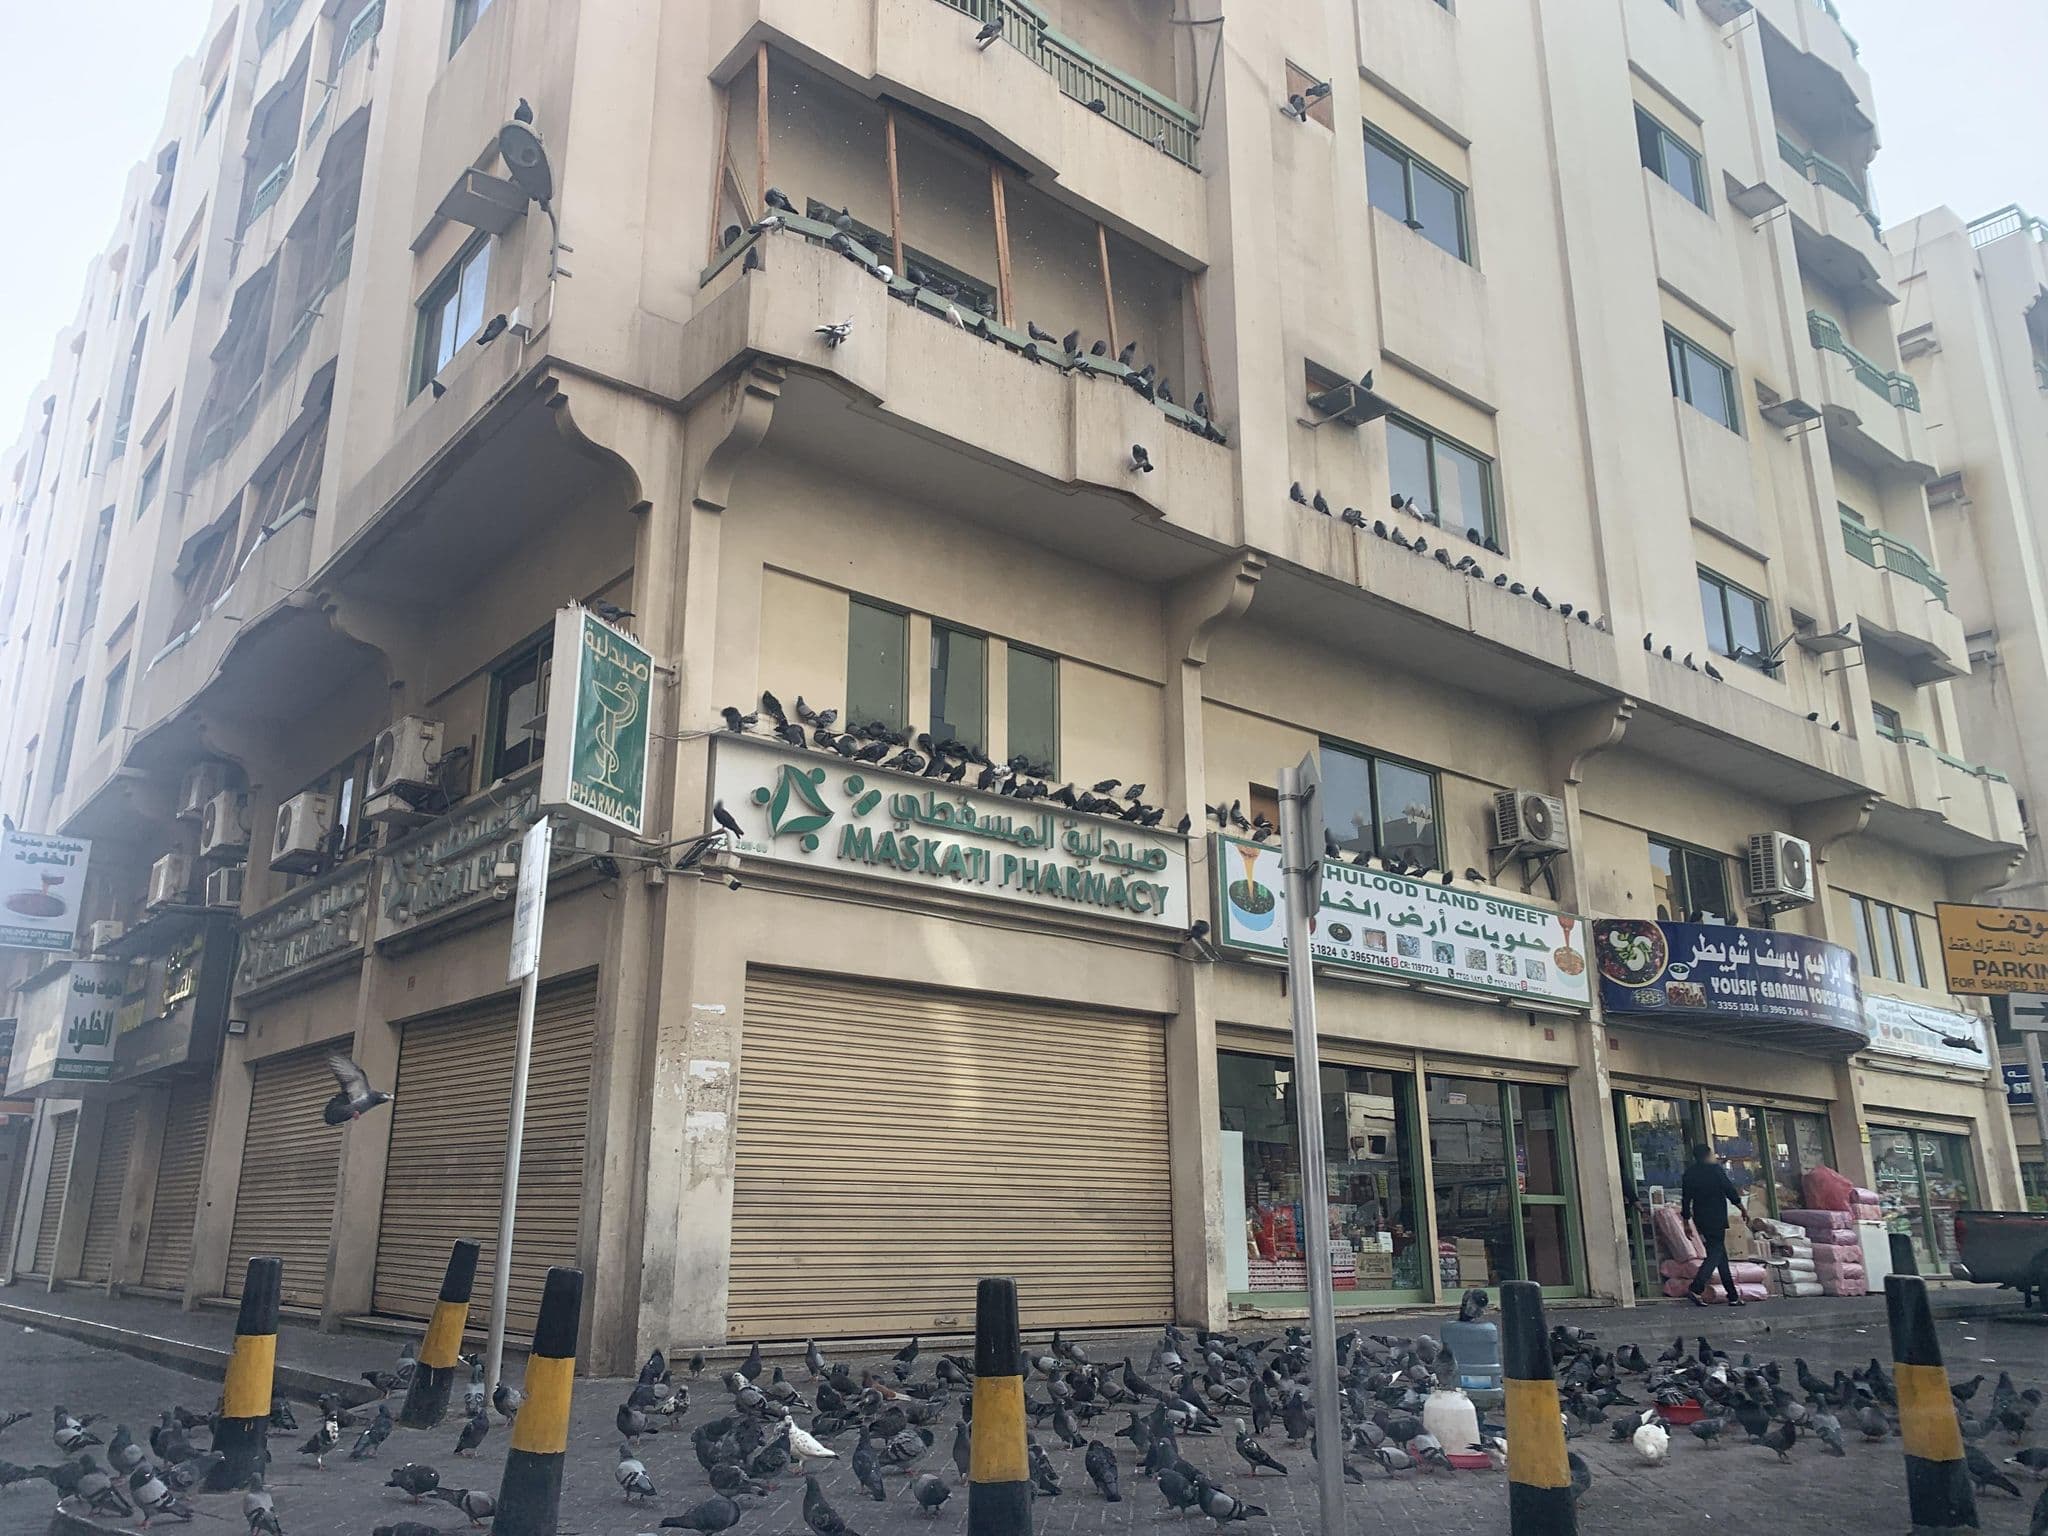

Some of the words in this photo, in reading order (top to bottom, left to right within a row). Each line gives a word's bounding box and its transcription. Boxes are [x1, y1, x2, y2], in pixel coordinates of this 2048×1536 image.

[583, 622, 649, 682] صيدلية
[571, 782, 640, 829] PHARMACY
[889, 791, 1054, 850] المسقطي
[15, 850, 75, 866] الخلود
[46, 839, 83, 852] حلويات
[1063, 819, 1168, 877] صيدلية
[838, 823, 990, 884] MASKATI
[997, 853, 1169, 916] PHARMACY
[1321, 864, 1418, 897] HULOOD
[1425, 888, 1479, 911] LAND
[1486, 901, 1549, 926] SWEET
[1387, 905, 1447, 937] أرض
[1454, 919, 1550, 953] حلويات
[1317, 944, 1338, 957] 1824
[1350, 949, 1390, 967] 39657146
[1686, 933, 1750, 971] شويطر
[1755, 938, 1802, 980] يوسف
[1711, 976, 1757, 995] YOUSIF
[1952, 977, 1976, 989] FOR
[1981, 979, 2028, 992] SHARED
[1717, 1001, 1738, 1011] 3355
[1740, 1003, 1759, 1012] 1824
